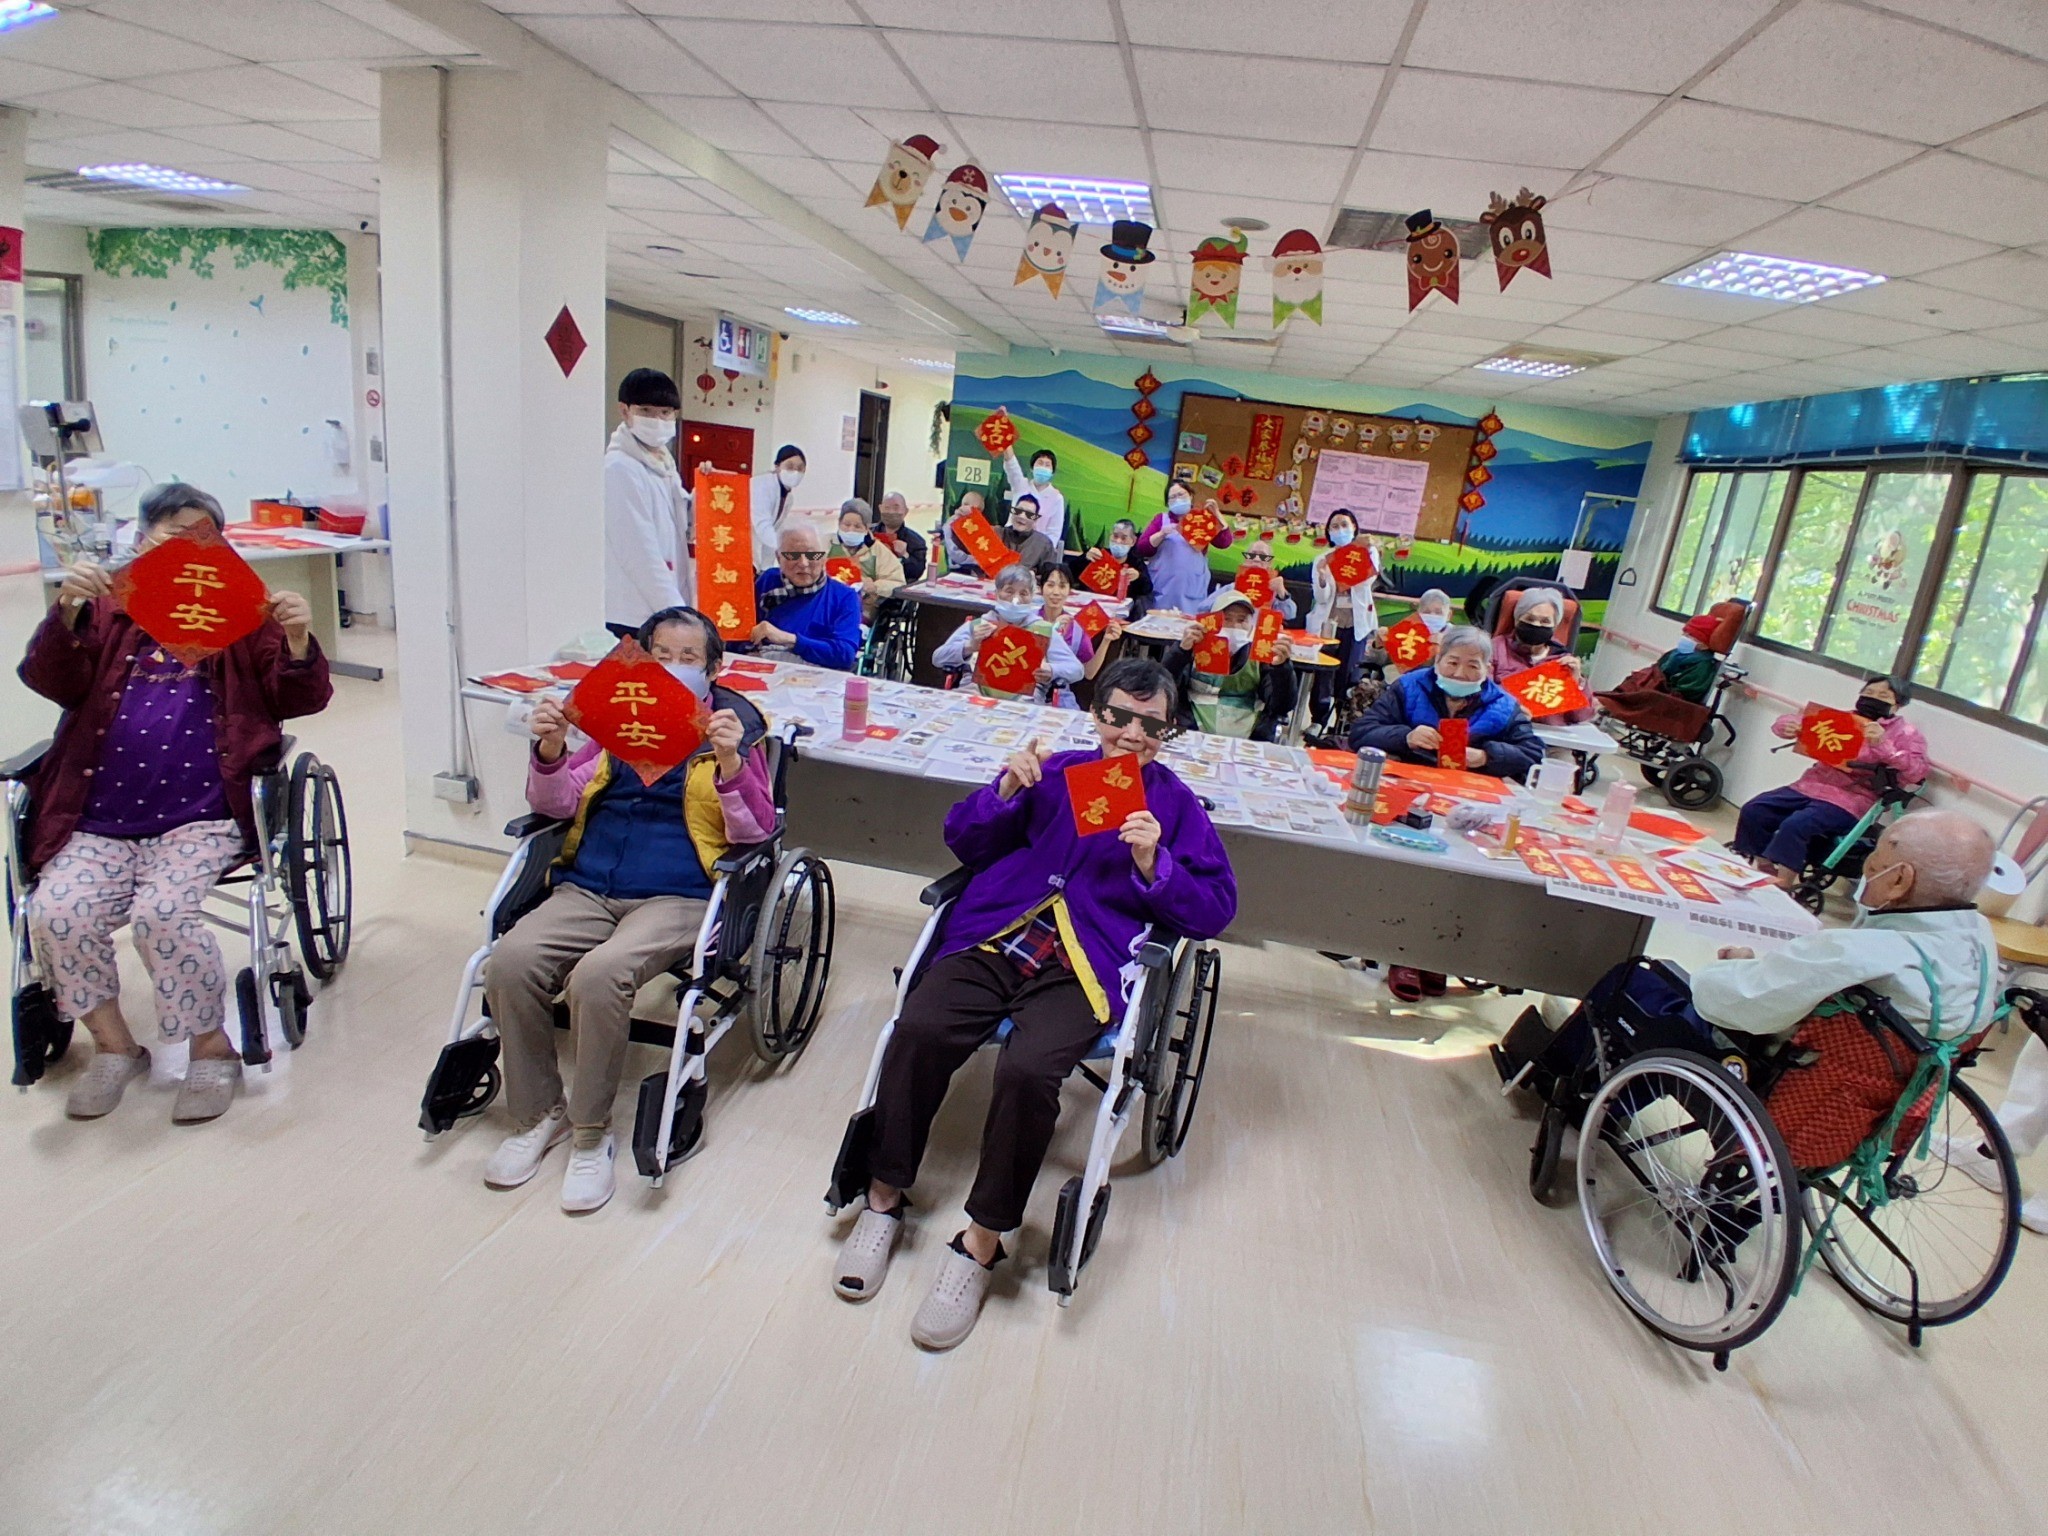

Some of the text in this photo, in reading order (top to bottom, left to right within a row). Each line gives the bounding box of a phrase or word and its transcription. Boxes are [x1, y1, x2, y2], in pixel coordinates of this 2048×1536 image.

[985, 419, 1009, 446] 吉
[965, 466, 982, 483] 2B
[1191, 514, 1208, 540] 平安
[709, 484, 741, 629] 萬事如意
[1339, 550, 1362, 579] 平安
[169, 563, 227, 632] 平安
[1245, 573, 1263, 601] 平安
[1394, 628, 1426, 661] 吉
[1520, 673, 1565, 709] 福
[609, 681, 667, 750] 平安
[1809, 719, 1854, 753] 春
